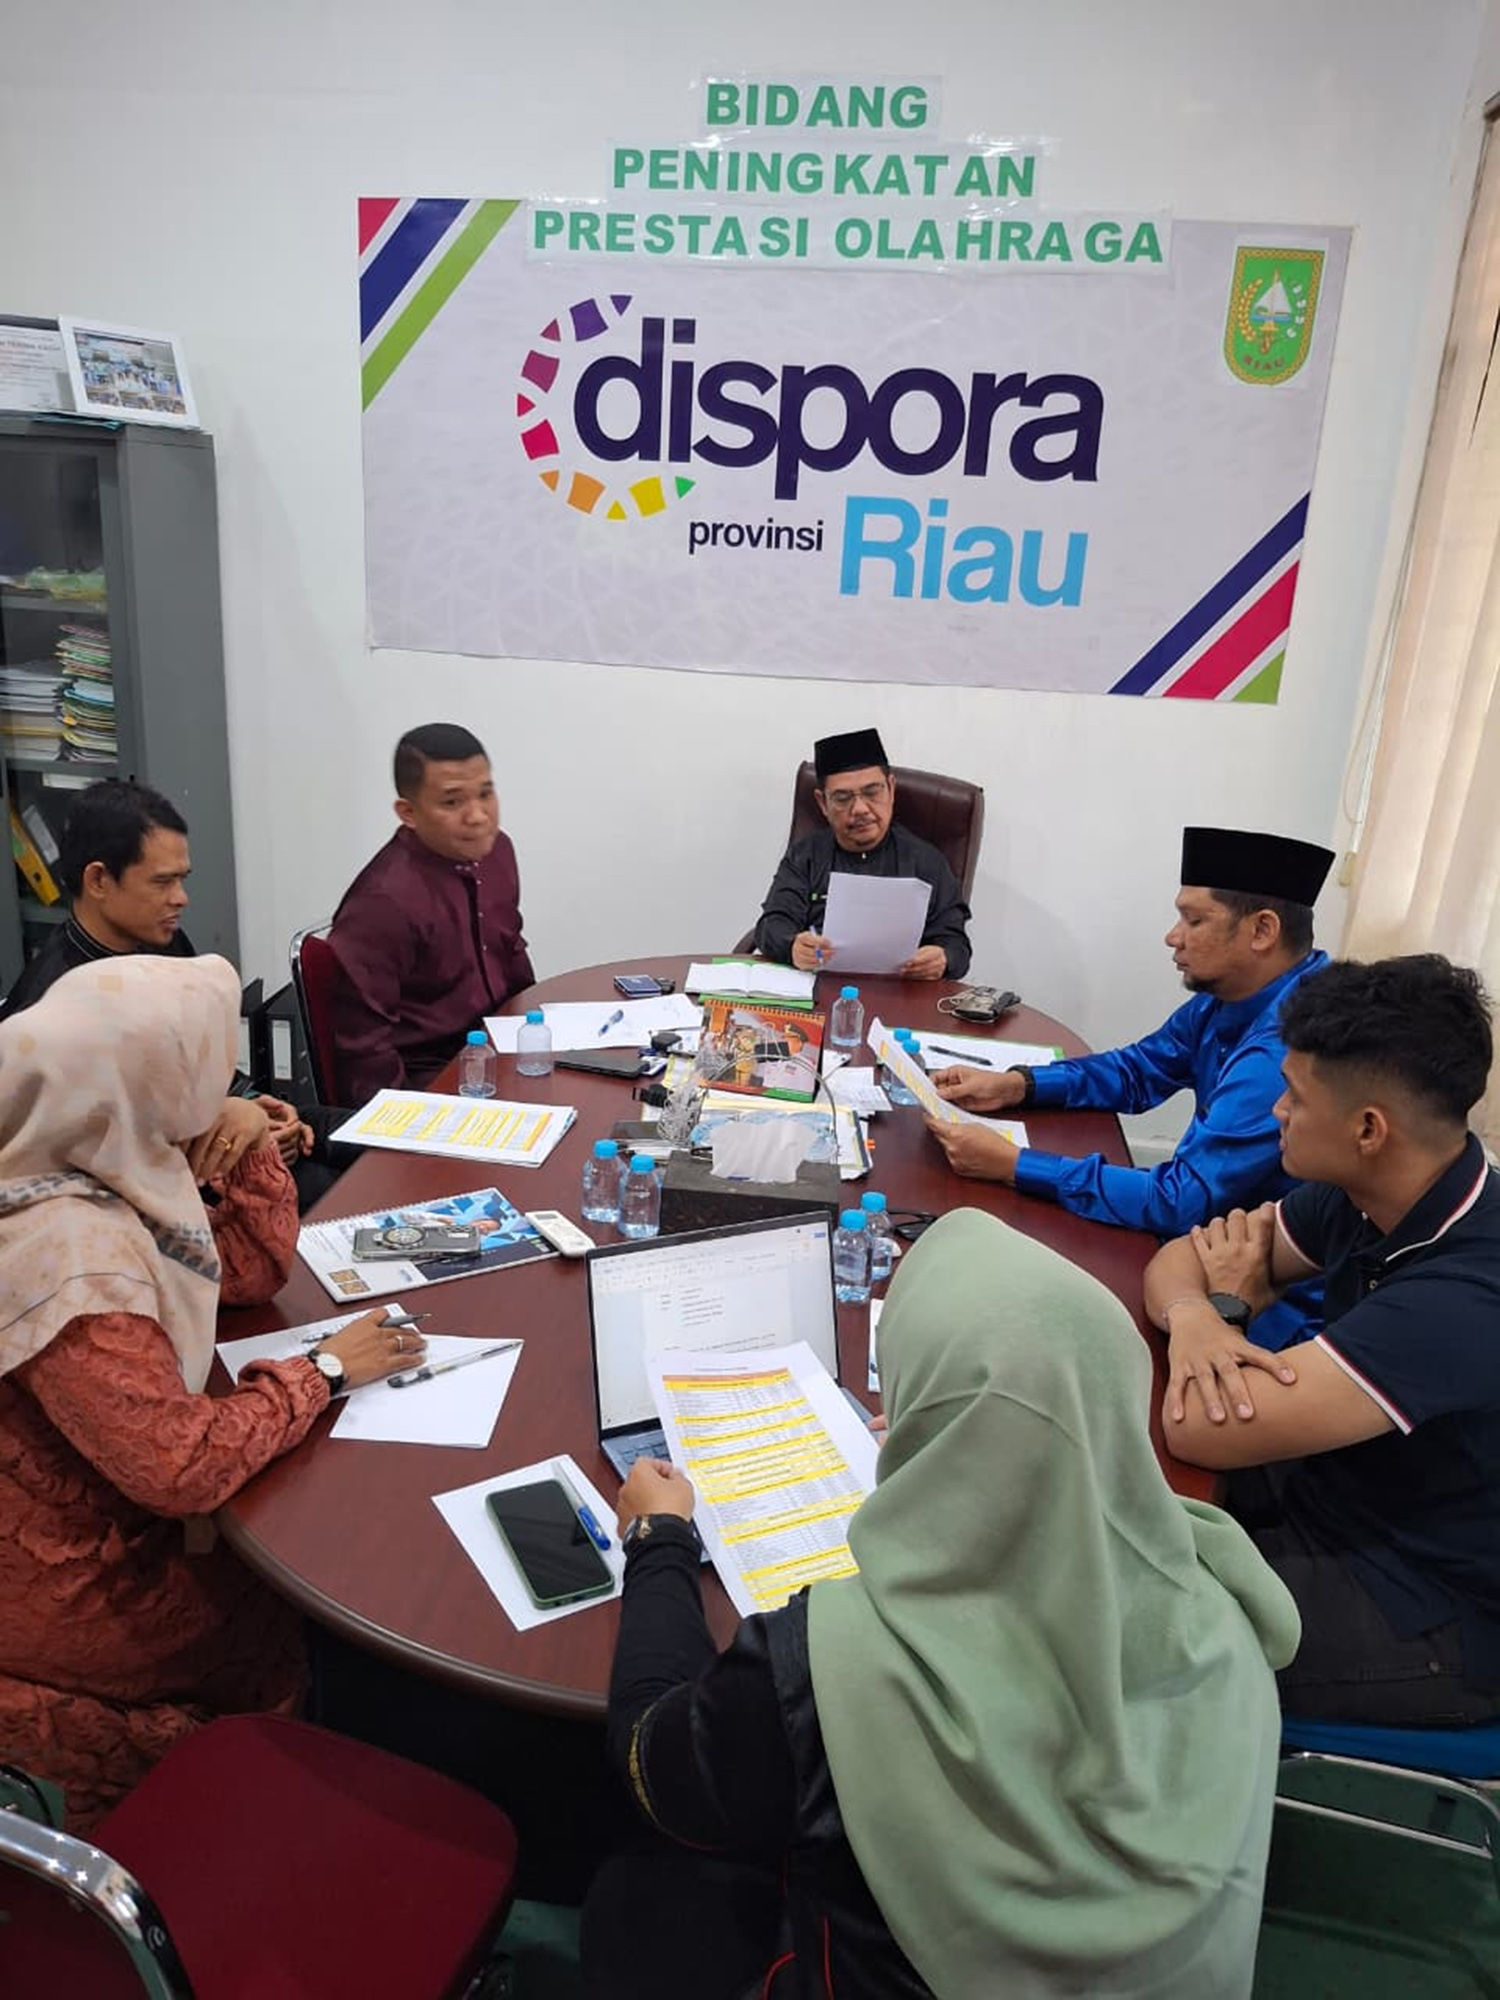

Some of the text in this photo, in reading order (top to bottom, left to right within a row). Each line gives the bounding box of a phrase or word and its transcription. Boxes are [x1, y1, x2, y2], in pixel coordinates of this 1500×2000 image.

[708, 85, 928, 129] BIDANG
[613, 149, 1035, 197] PENINGKATAN
[533, 211, 1164, 263] PRESTASI OLAHRAGA
[573, 317, 1104, 500] dispora
[689, 495, 1088, 607] provinsi Riau
